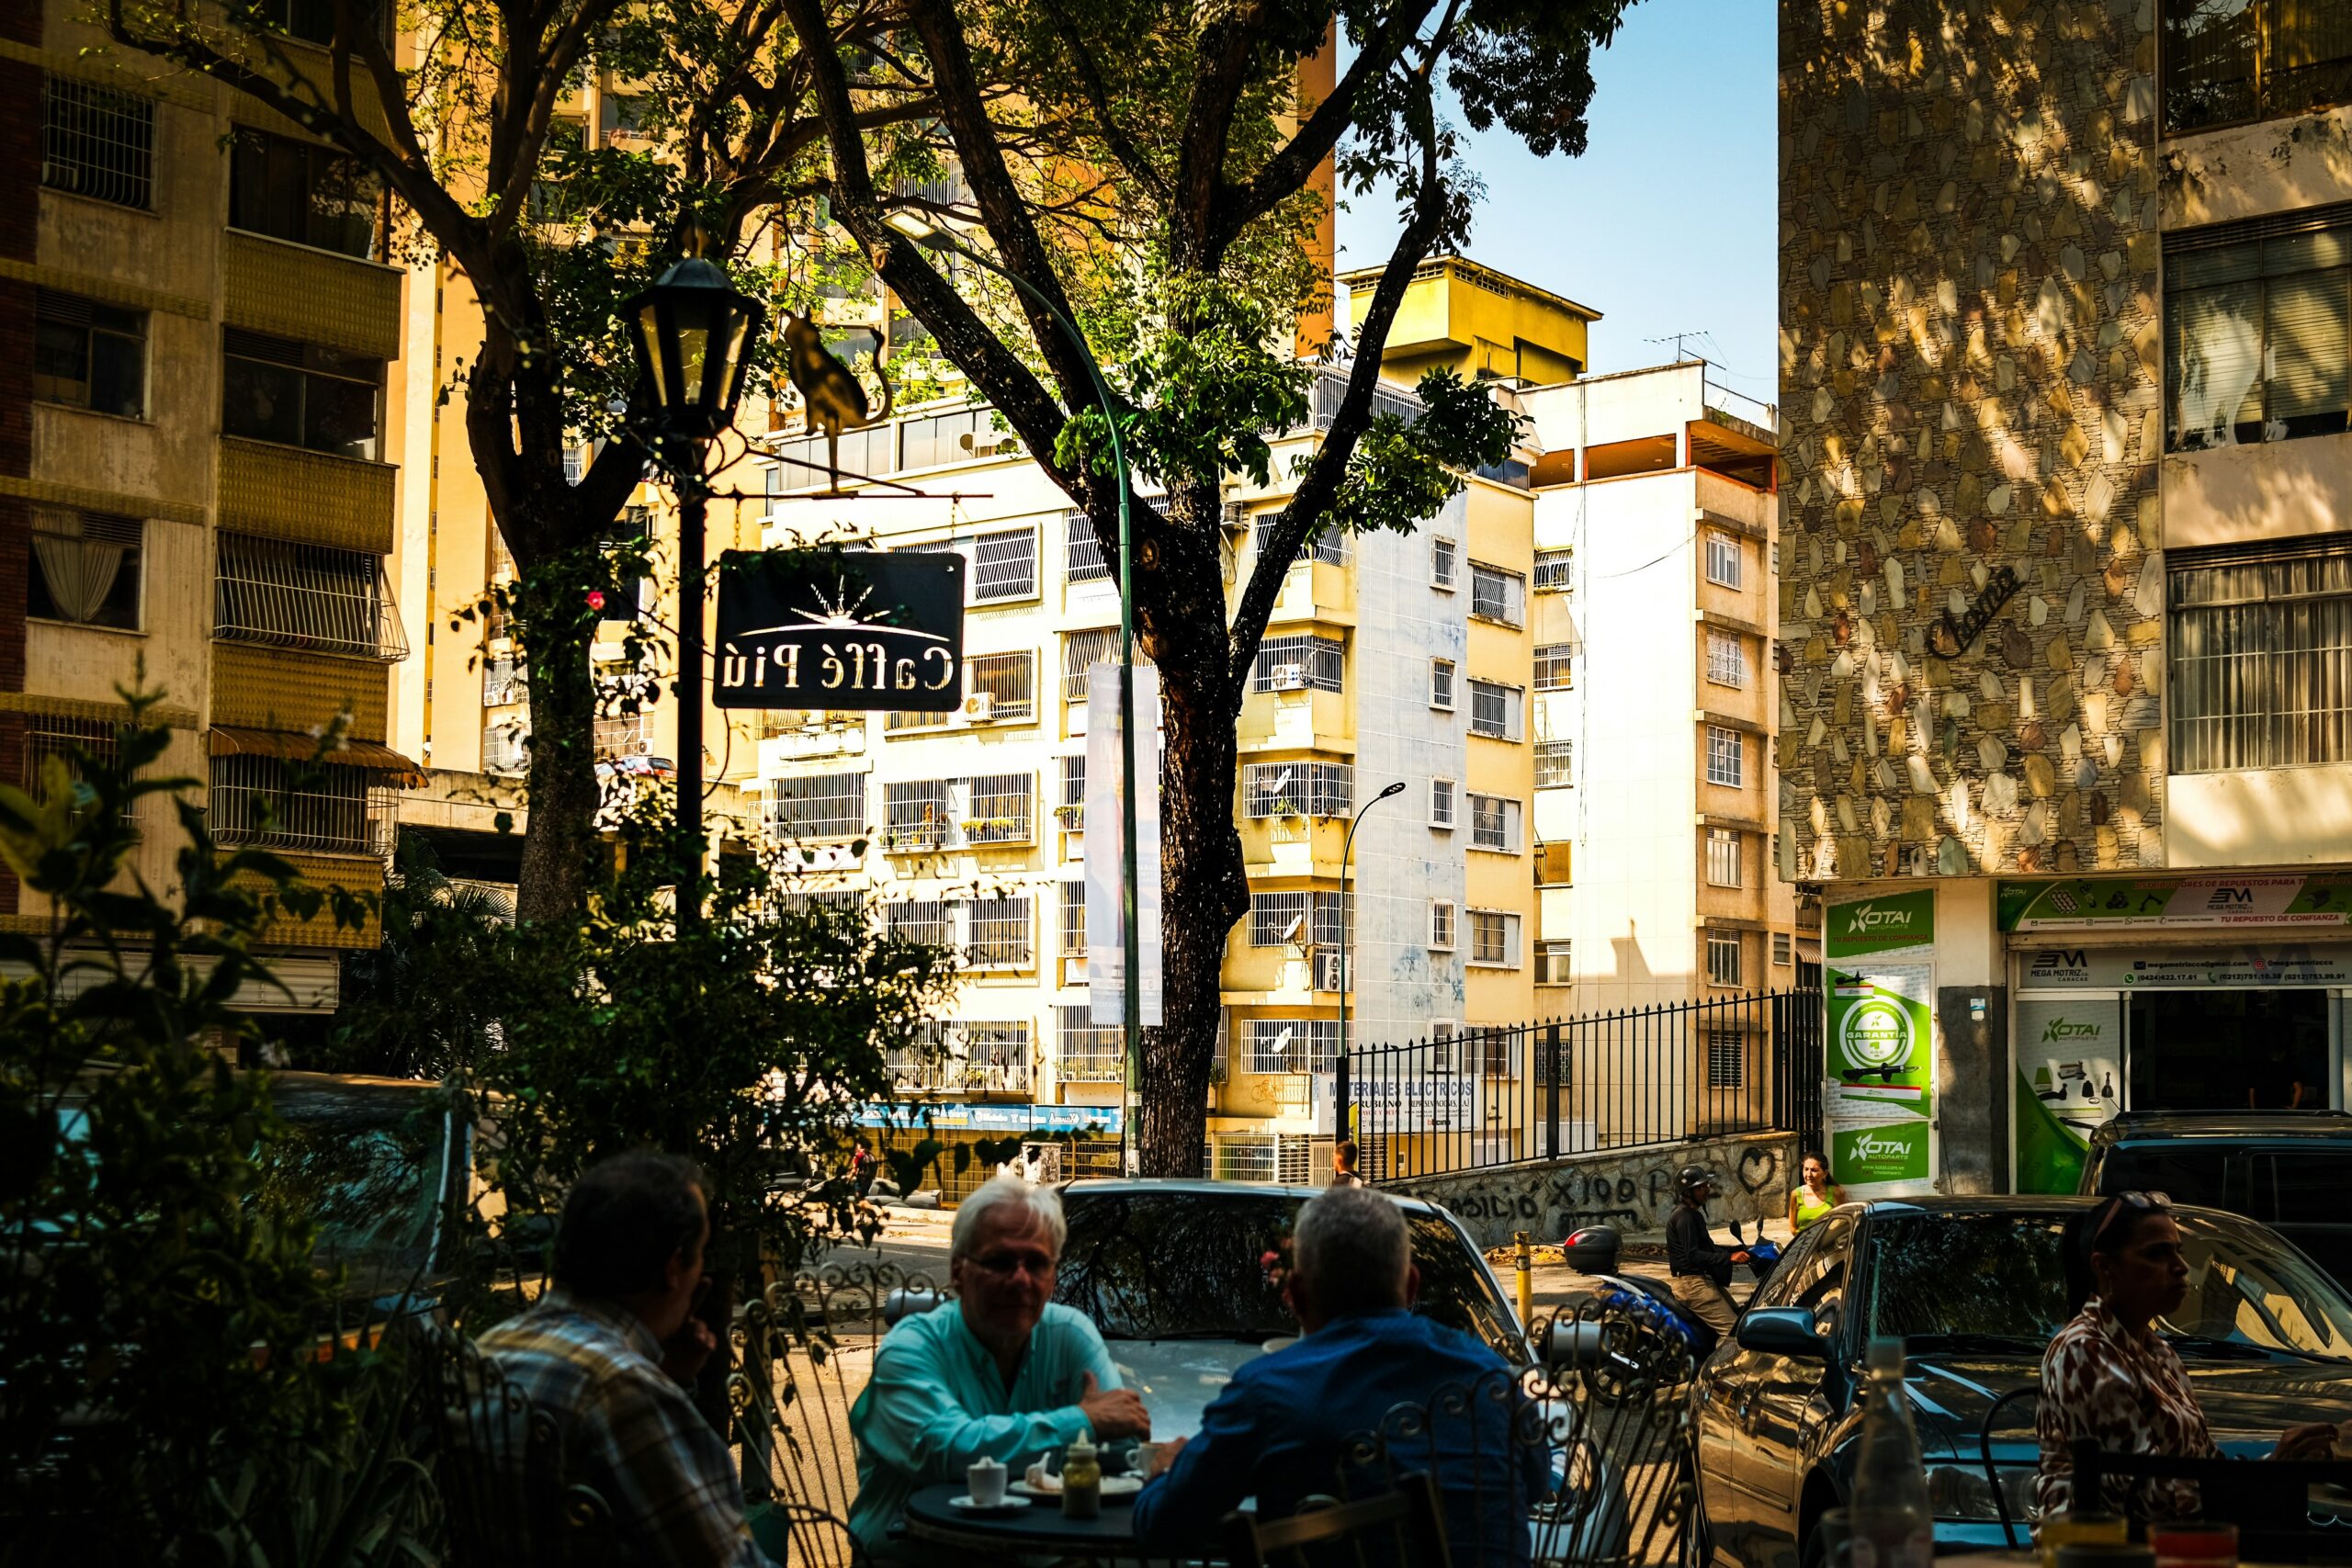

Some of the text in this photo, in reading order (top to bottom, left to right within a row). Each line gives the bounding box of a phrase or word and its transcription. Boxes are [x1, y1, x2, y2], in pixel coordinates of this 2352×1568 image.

[2218, 879, 2269, 887] REPUESTOS
[2271, 878, 2295, 886] PARA
[1848, 903, 1913, 934] KOTAI
[2232, 915, 2275, 923] REPUESTO
[2290, 914, 2339, 922] CONFIANZA
[2030, 969, 2052, 977] MEGA
[2052, 969, 2081, 977] MOTRIZ
[2041, 1016, 2101, 1043] KOTAI
[1329, 1081, 1472, 1097] MTERIALES ELECTRCOS
[1849, 1132, 1912, 1162] KOTAI
